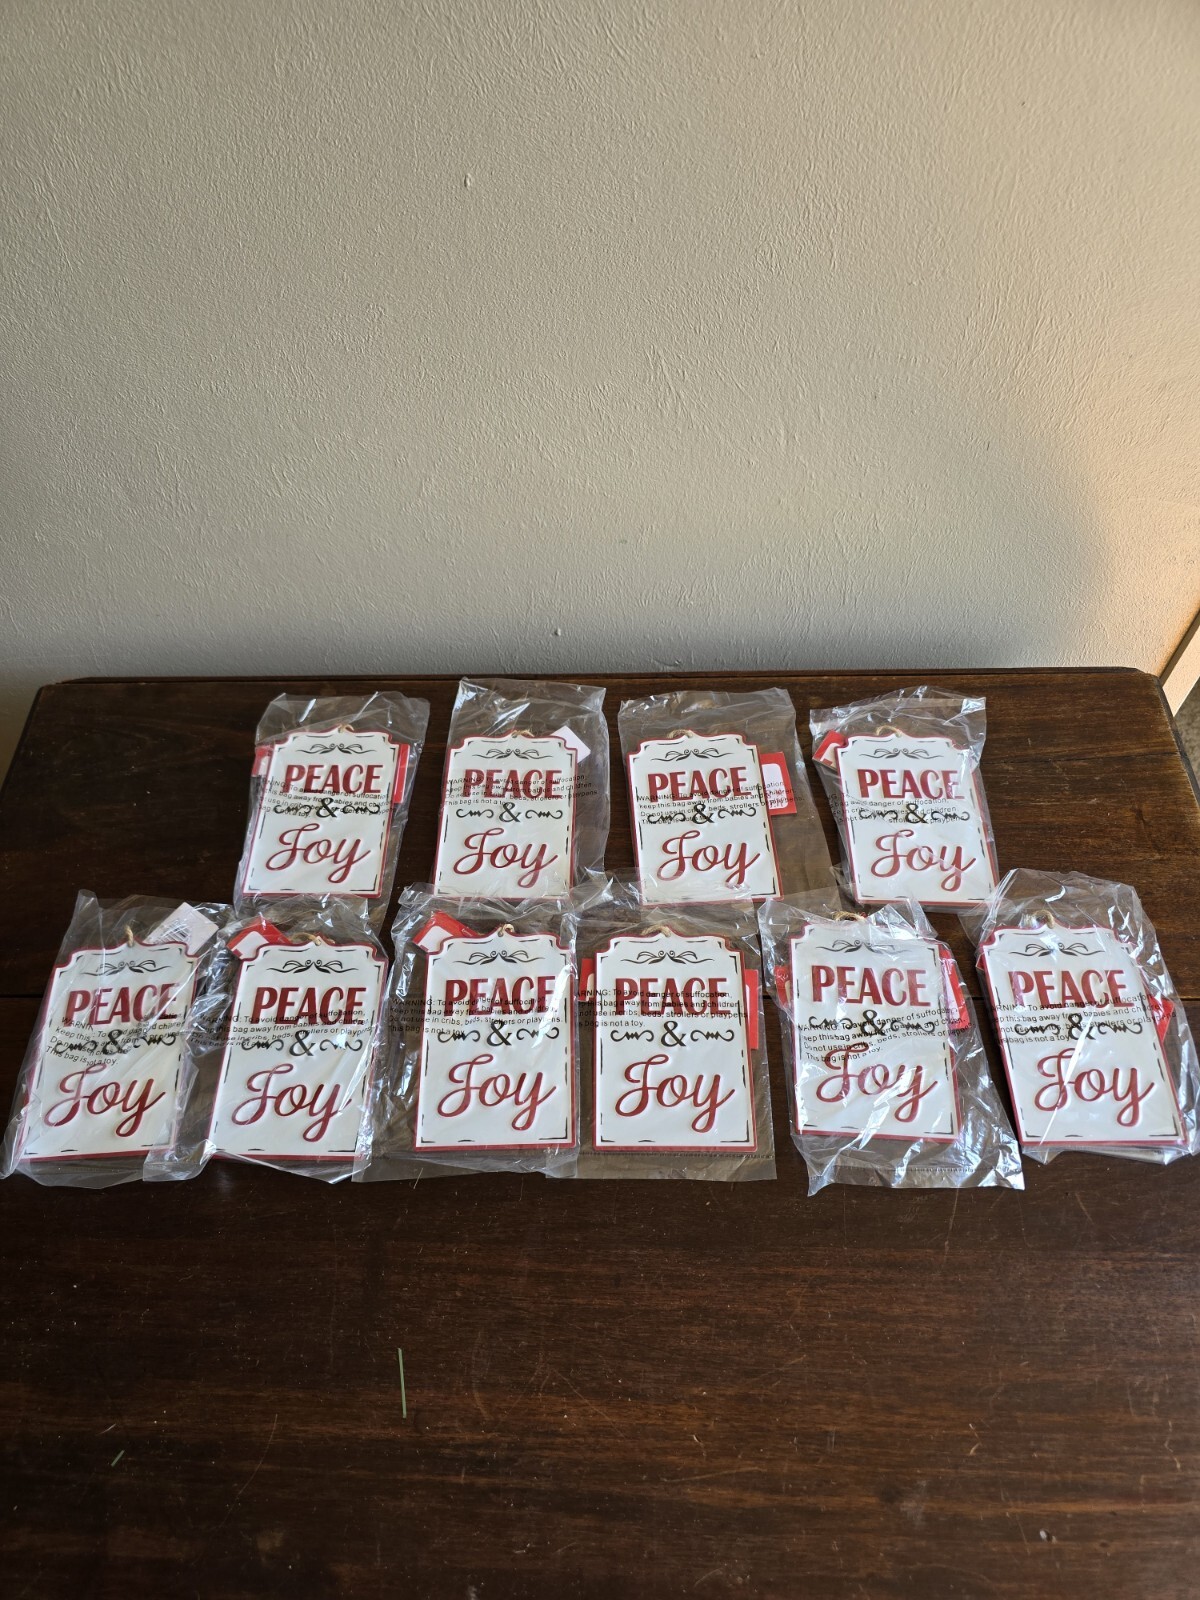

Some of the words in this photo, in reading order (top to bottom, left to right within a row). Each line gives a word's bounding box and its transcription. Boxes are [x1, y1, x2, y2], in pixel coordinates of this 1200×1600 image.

[283, 764, 383, 794] PEACE
[463, 769, 562, 799] PEACE
[647, 766, 751, 803] PEACE
[857, 768, 964, 799] PEACE
[316, 797, 337, 818] &
[499, 802, 521, 822] &
[673, 800, 686, 808] bag
[692, 803, 715, 824] &
[730, 802, 759, 810] strollers
[870, 800, 895, 808] danger
[905, 803, 928, 824] &
[266, 823, 371, 884] Joy
[454, 828, 559, 888] Joy
[656, 829, 760, 888] Joy
[871, 829, 976, 892] Joy
[444, 975, 555, 1016] PEACE
[615, 977, 730, 1016] PEACE
[811, 965, 931, 1007] PEACE
[1008, 969, 1135, 1008] PEACE
[63, 983, 179, 1027] PEACE
[251, 986, 366, 1025] PEACE
[907, 1013, 915, 1021] of
[1027, 1003, 1038, 1011] To
[1039, 1013, 1061, 1022] away
[98, 1030, 106, 1038] To
[233, 1026, 247, 1034] bag
[250, 1026, 271, 1034] away
[273, 1023, 292, 1031] from
[486, 1019, 512, 1046] &
[631, 1020, 647, 1029] toy.
[660, 1020, 686, 1047] &
[860, 1009, 886, 1036] &
[1067, 1013, 1095, 1040] &
[101, 1029, 128, 1055] &
[289, 1029, 316, 1056] &
[1035, 1034, 1049, 1042] not
[64, 1052, 79, 1063] bag
[437, 1054, 556, 1131] Joy
[615, 1054, 735, 1133] Joy
[816, 1042, 937, 1122] Joy
[1034, 1048, 1154, 1127] Joy
[44, 1062, 166, 1137] Joy
[231, 1064, 352, 1142] Joy
